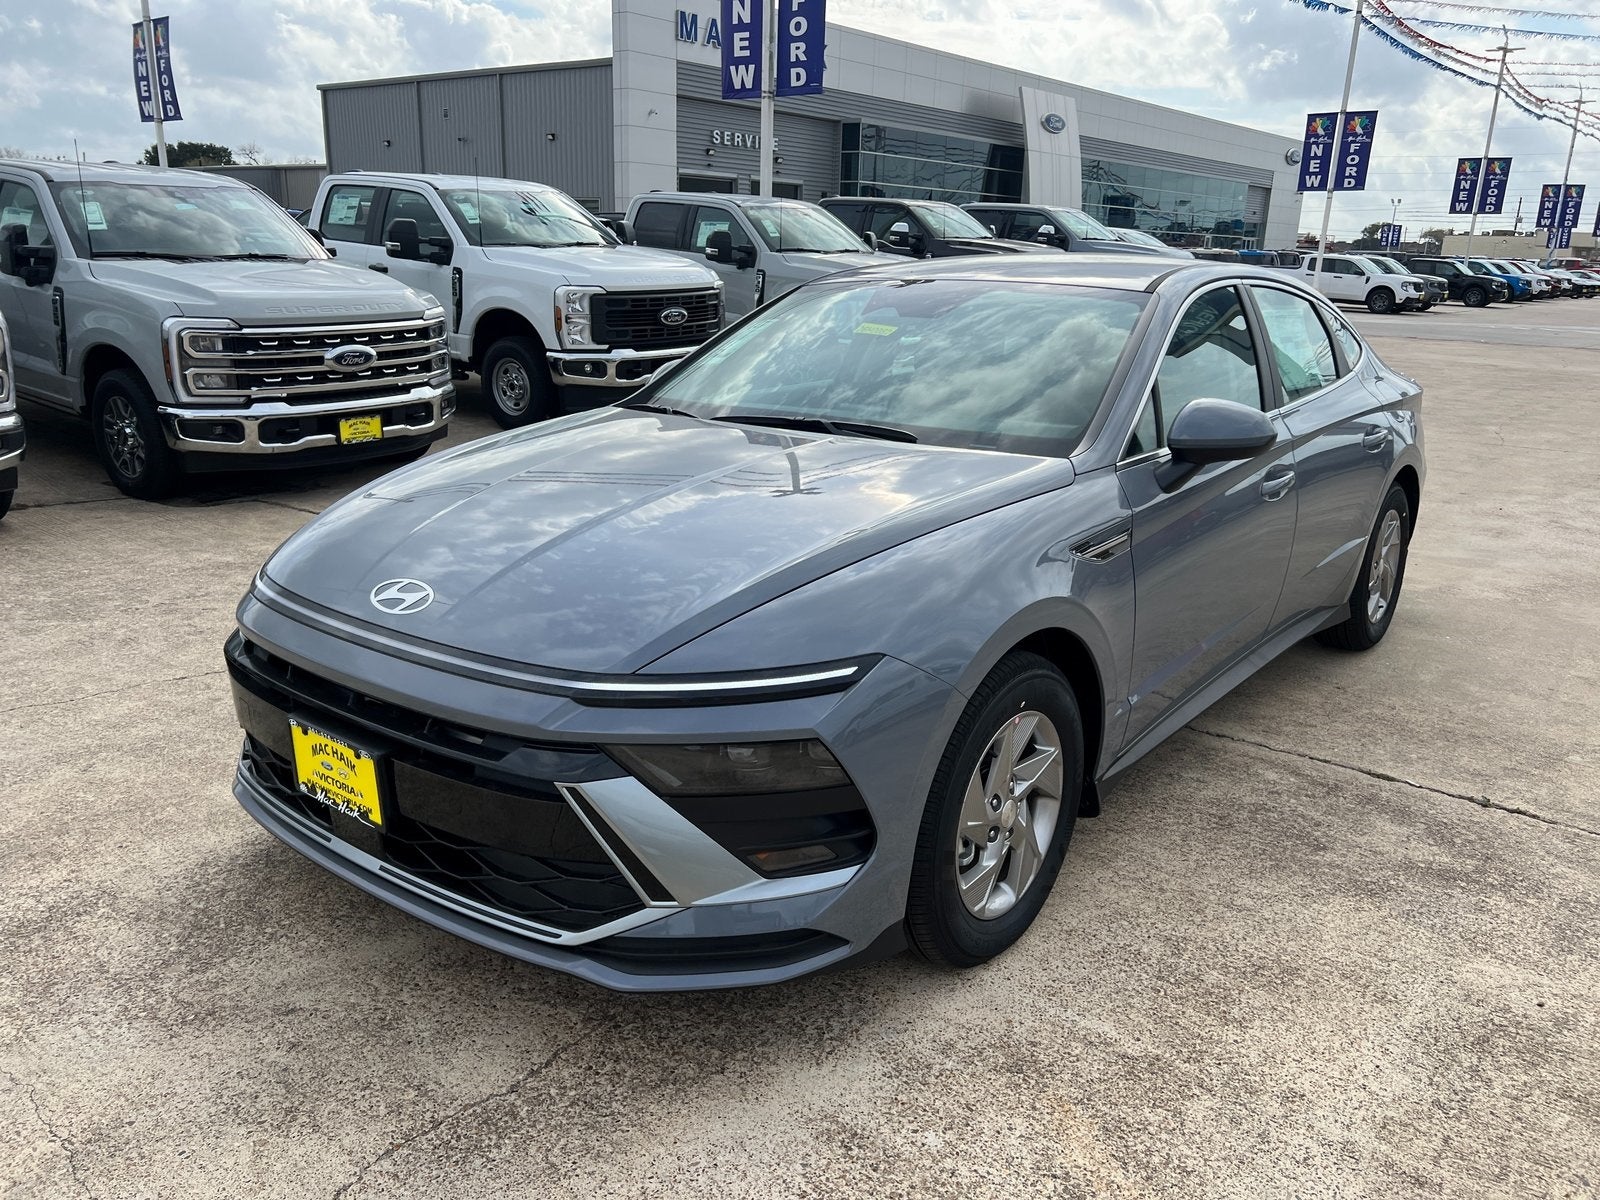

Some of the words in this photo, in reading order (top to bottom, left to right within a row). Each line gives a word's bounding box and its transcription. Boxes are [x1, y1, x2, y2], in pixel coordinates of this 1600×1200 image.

[676, 10, 722, 49] MA
[730, 0, 755, 90] NEW
[137, 61, 154, 117] NEW
[160, 59, 175, 117] FORD
[712, 129, 779, 151] SERVIE
[1305, 144, 1324, 188] NEW
[1343, 143, 1361, 188] FORD
[1455, 180, 1471, 212] NEW
[1485, 180, 1500, 212] FORD
[1540, 201, 1553, 226] NEW
[1564, 201, 1576, 227] FORD
[264, 304, 349, 315] SUPER
[350, 301, 406, 312] DUTY
[311, 742, 331, 757] MAC
[331, 745, 358, 777] HAIK
[318, 771, 357, 797] VICTORIA
[315, 790, 337, 808] Mac
[337, 802, 361, 818] Haik
